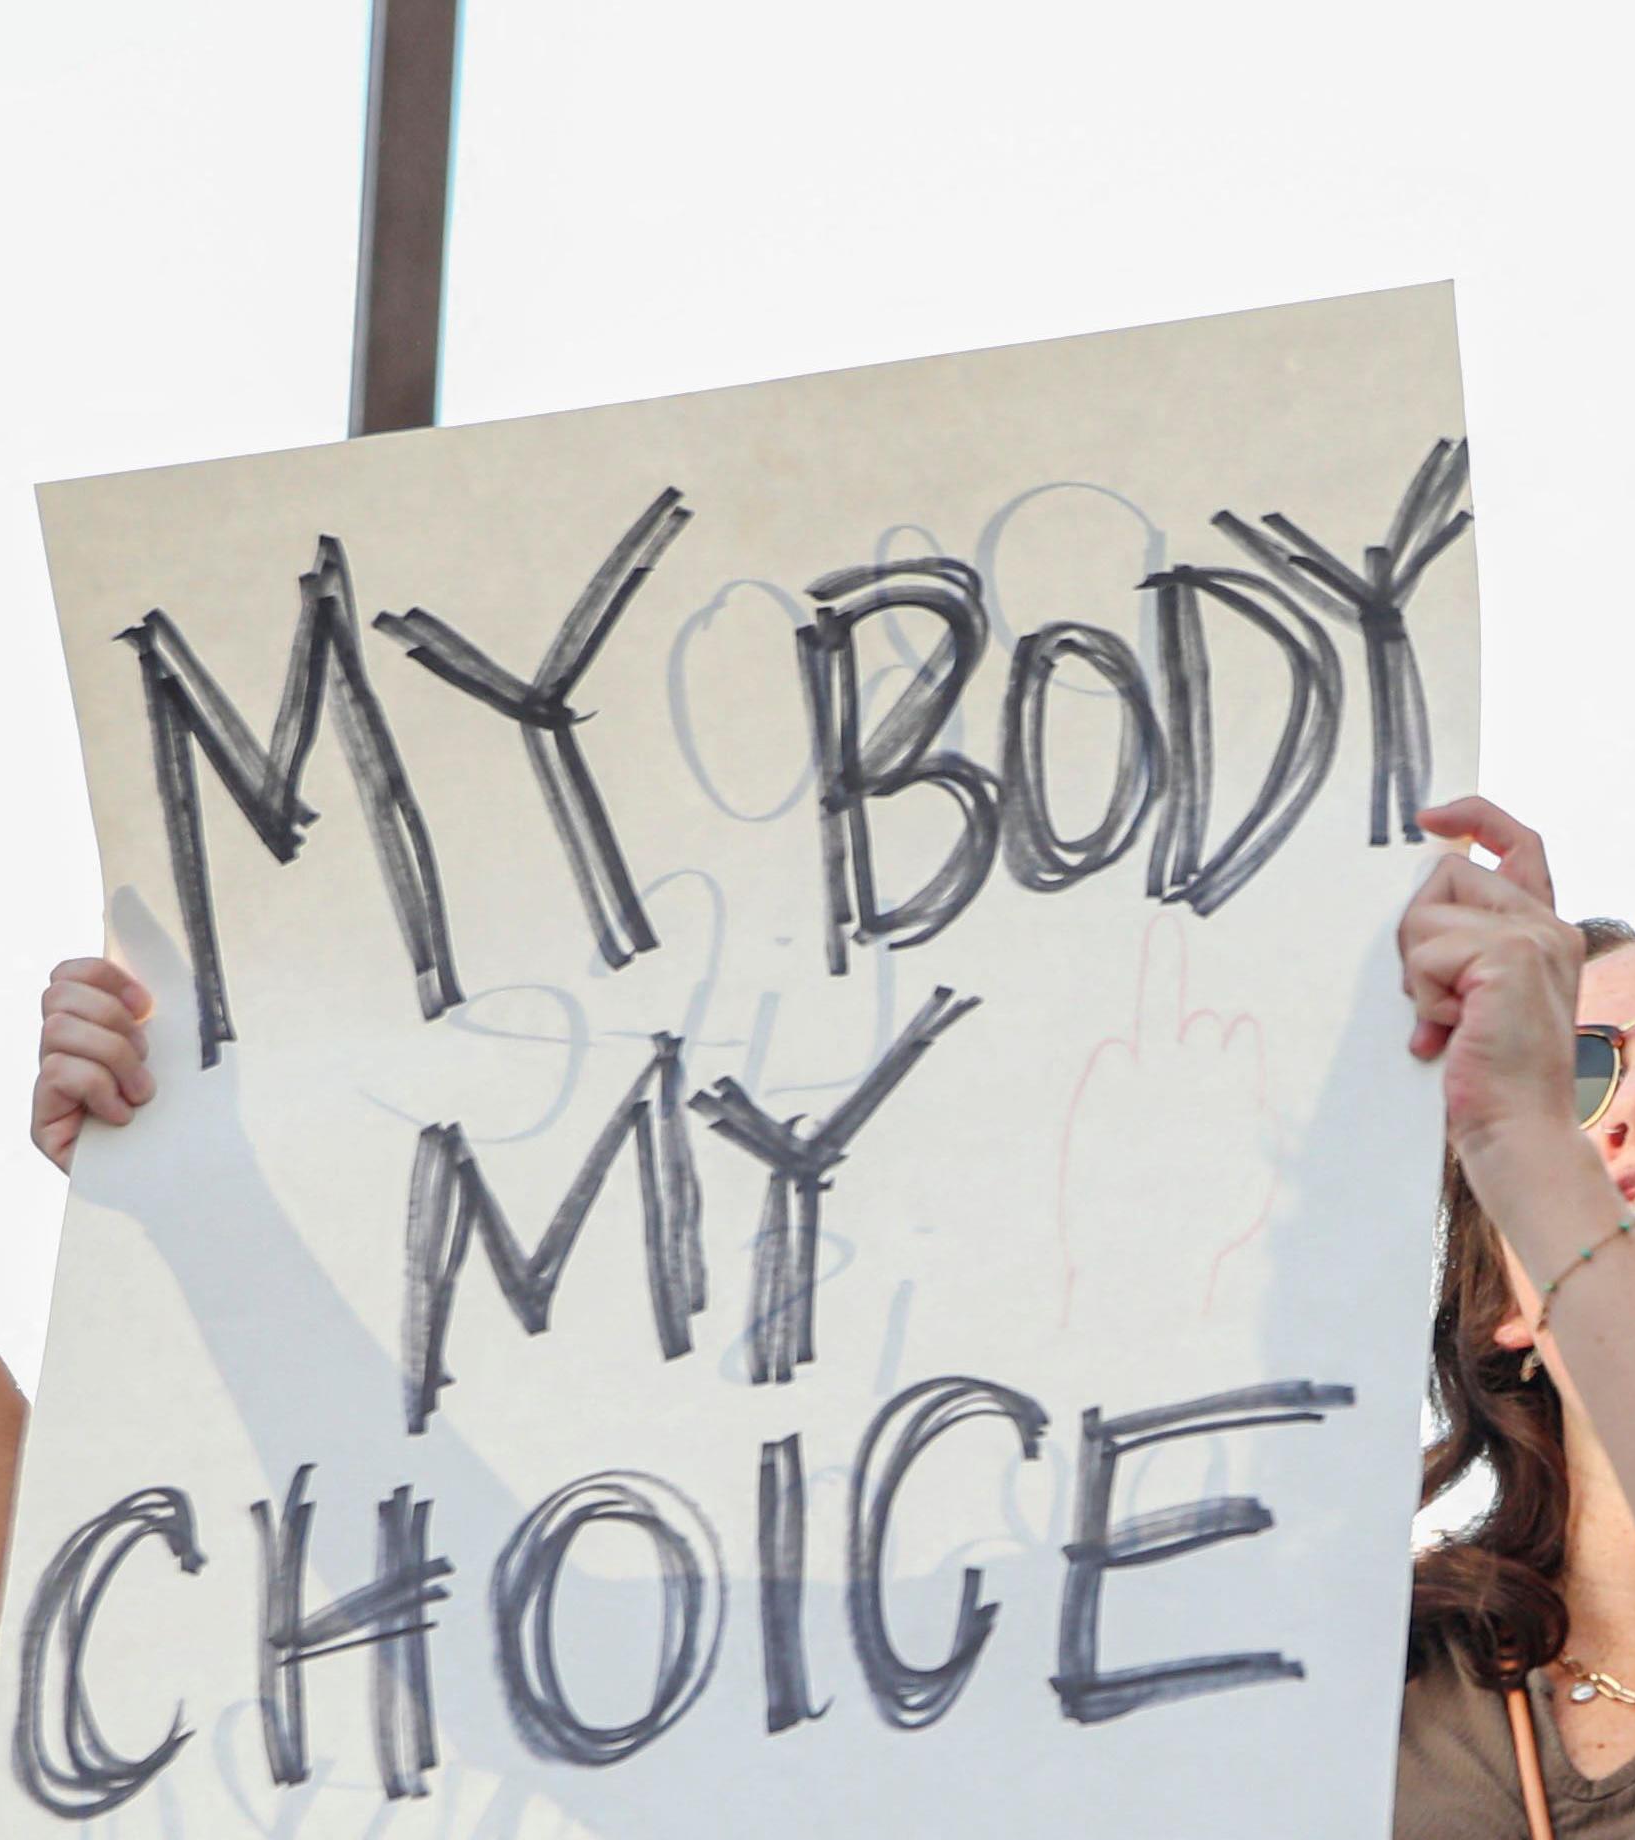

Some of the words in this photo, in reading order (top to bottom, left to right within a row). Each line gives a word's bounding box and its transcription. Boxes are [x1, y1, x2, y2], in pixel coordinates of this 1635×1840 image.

[113, 485, 694, 1070] MY
[795, 436, 1473, 975] BODY
[405, 985, 984, 1435] MY
[13, 1376, 1356, 1821] CHOICE
